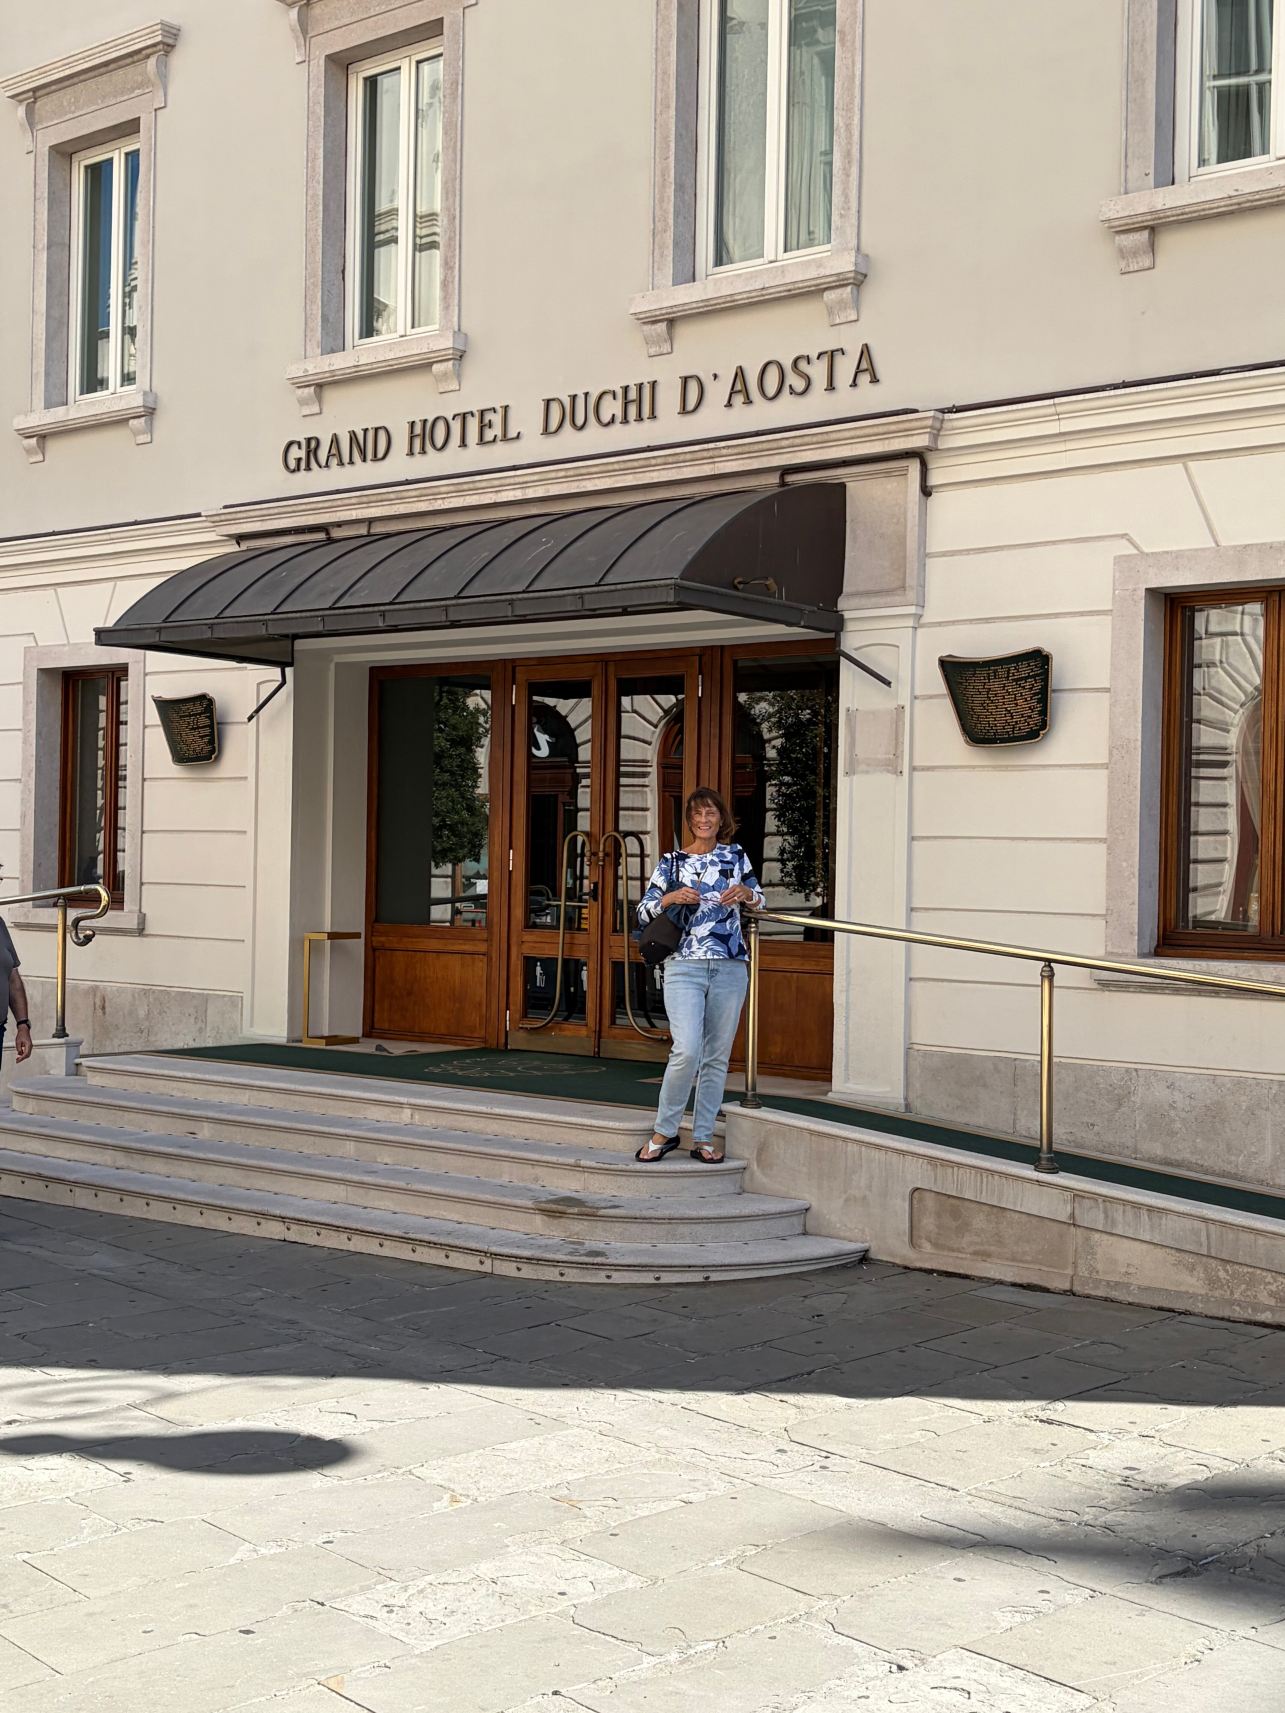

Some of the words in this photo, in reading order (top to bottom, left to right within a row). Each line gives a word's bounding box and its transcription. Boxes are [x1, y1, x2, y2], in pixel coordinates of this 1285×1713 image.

[281, 424, 392, 474] GRAND
[405, 404, 521, 456] HOTEL
[540, 379, 658, 437] DUCHI
[677, 342, 880, 416] D'AOSTA
